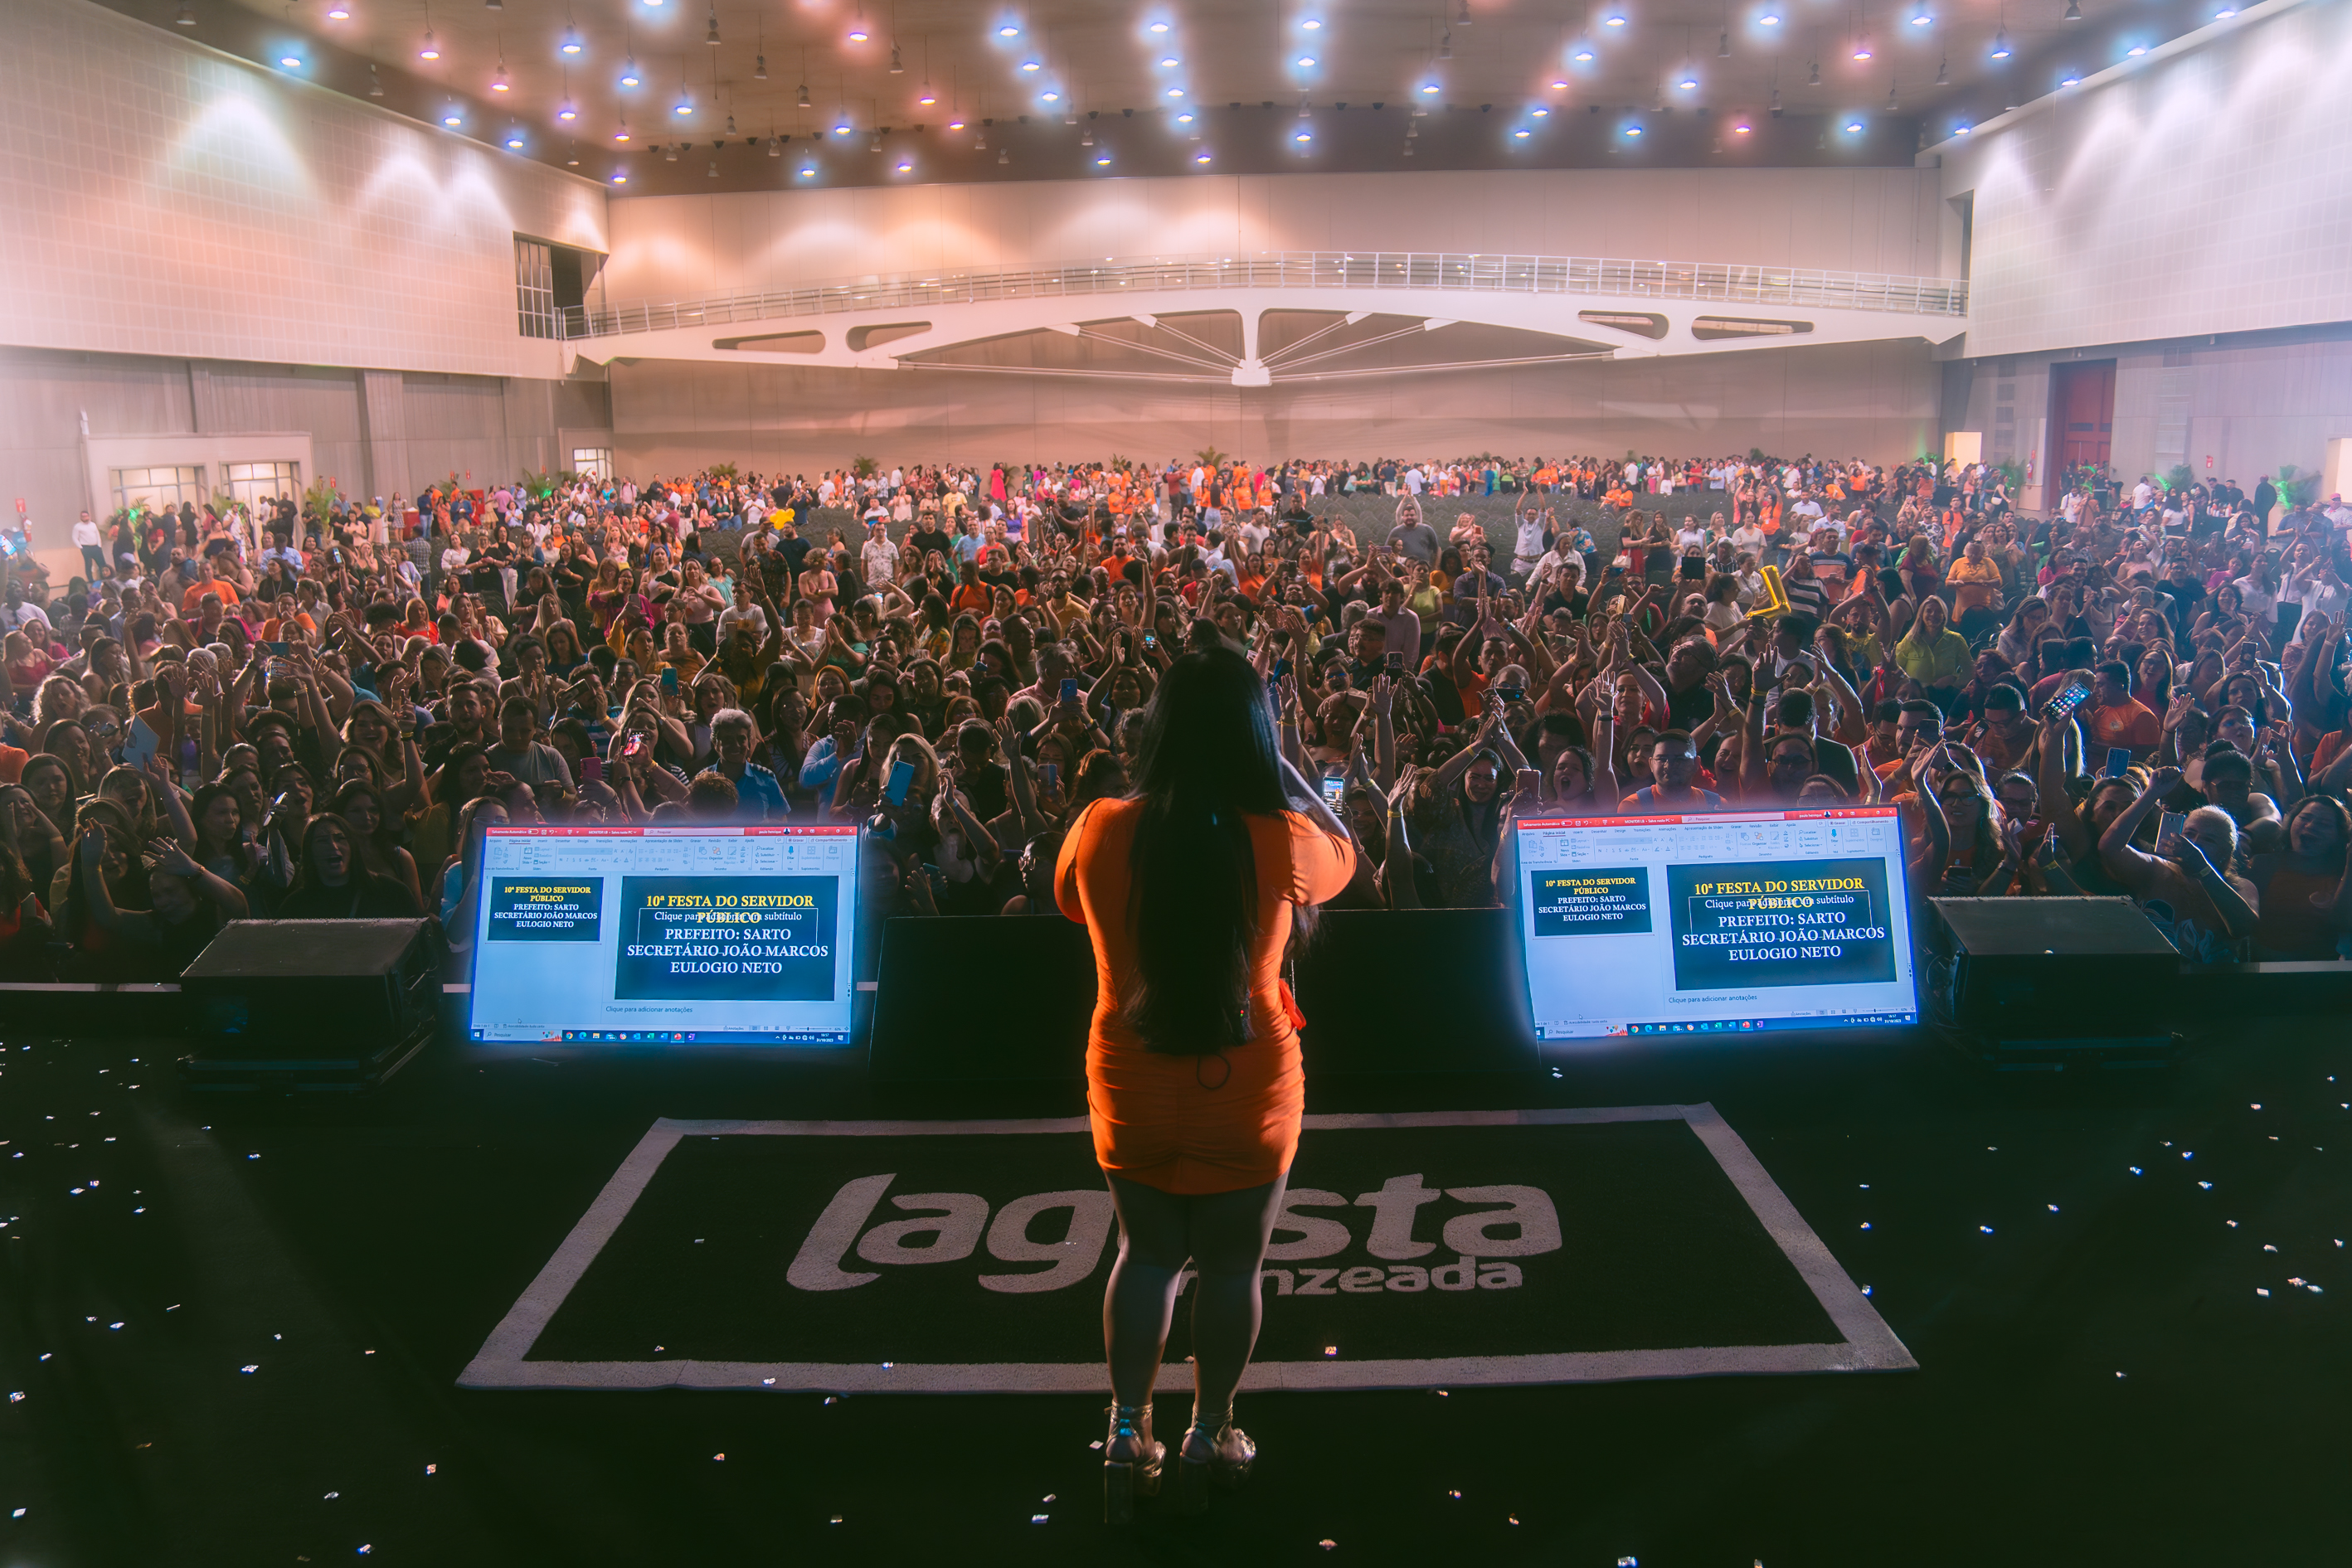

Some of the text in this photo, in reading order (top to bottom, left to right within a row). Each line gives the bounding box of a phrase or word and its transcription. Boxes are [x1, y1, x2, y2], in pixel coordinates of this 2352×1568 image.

[1573, 886, 1609, 895] PÚBLICO
[1694, 878, 1864, 895] 10ª FESTA DO SERVIDOR
[646, 896, 814, 907] 10ª FESTA DO SERVIDOR
[1538, 905, 1588, 913] SECRETÁRIO
[1590, 904, 1611, 912] JOÃO
[1705, 900, 1733, 910] Clique
[1736, 900, 1755, 909] para
[1816, 895, 1854, 904] subtítulo
[1748, 895, 1813, 910] PÚBLICO
[494, 910, 542, 919] SECRETÁRIO
[543, 911, 564, 920] JOÃO
[654, 911, 683, 922] Clique
[684, 913, 703, 922] para
[764, 911, 802, 920] subtítulo
[697, 909, 761, 923] PÚBLICO
[1718, 912, 1846, 927] PREFEITO: SARTO
[664, 929, 792, 939] PREFEITO: SARTO
[1682, 927, 1885, 945] SECRETÁRIO JOÃO MARCOS
[627, 943, 829, 957] SECRETÁRIO JOÃO MARCOS
[1728, 945, 1841, 960] EULOGIO NETO
[670, 962, 782, 973] EULOGIO NETO
[786, 1173, 1562, 1293] lagsta
